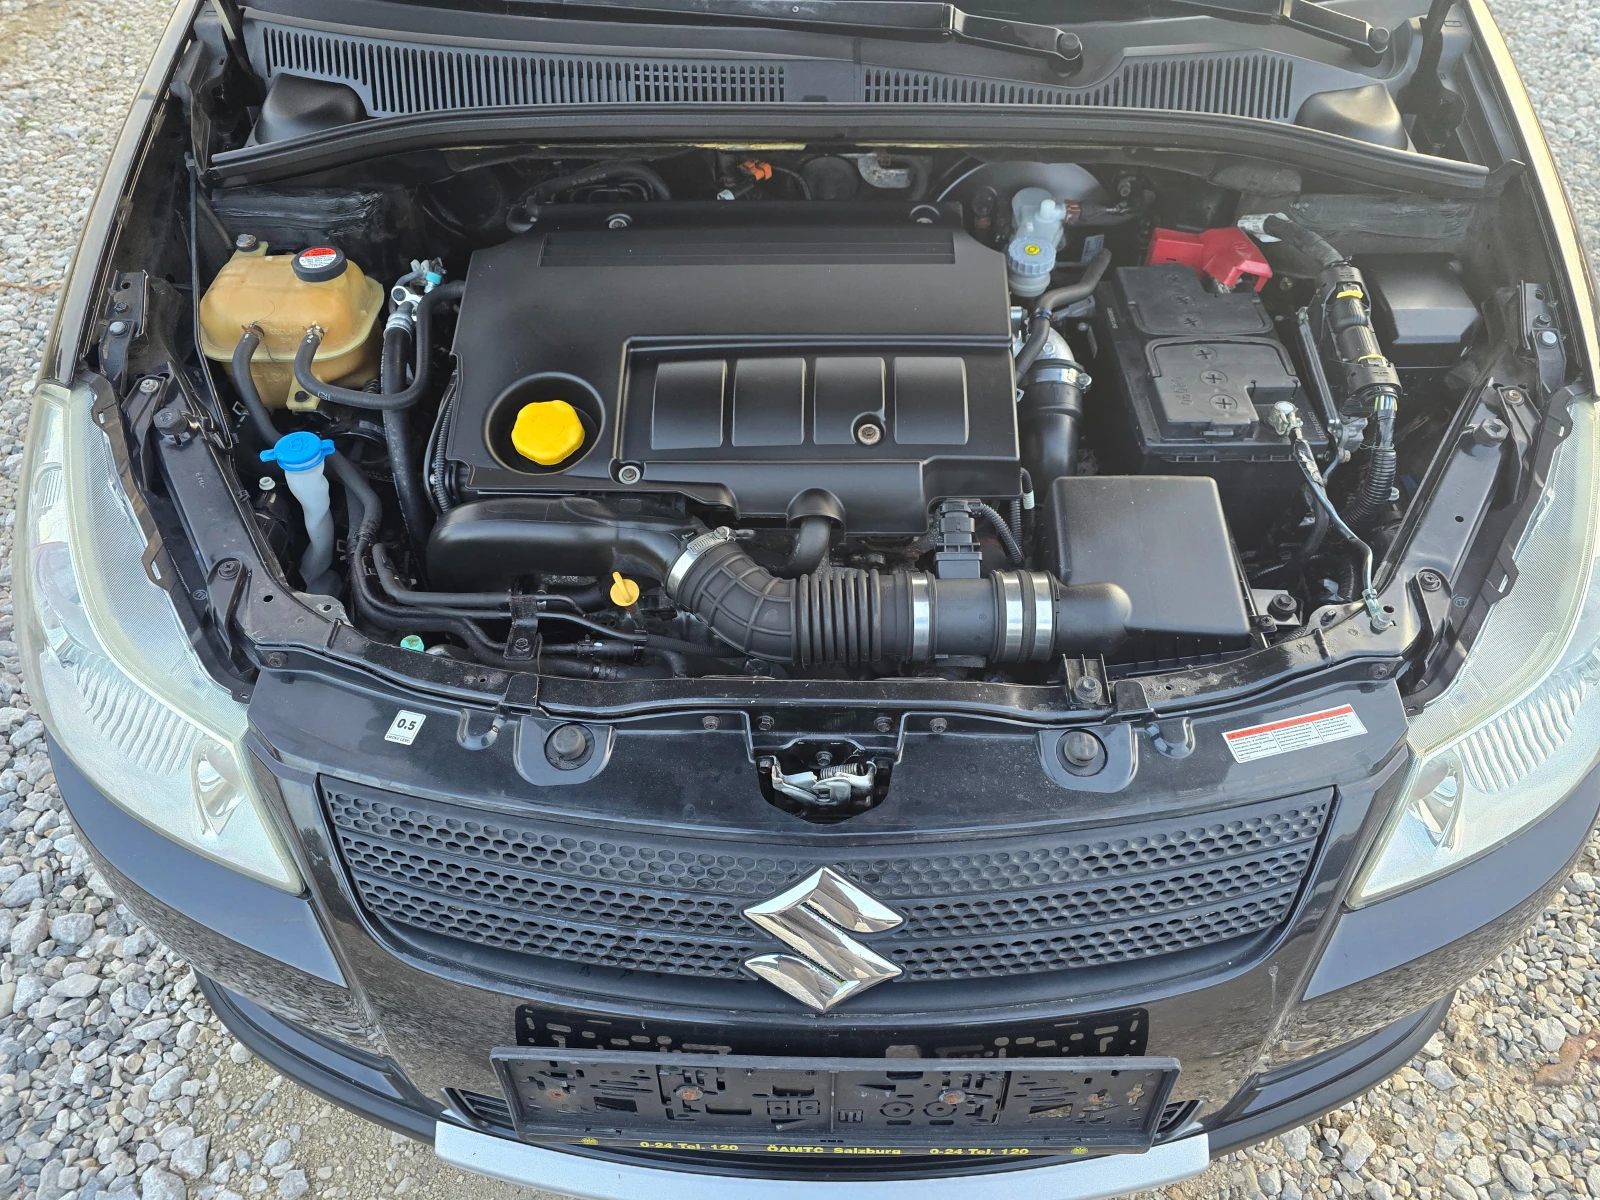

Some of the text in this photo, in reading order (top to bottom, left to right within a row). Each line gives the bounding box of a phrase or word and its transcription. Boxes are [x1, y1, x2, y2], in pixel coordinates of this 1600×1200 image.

[397, 718, 417, 731] 0.5
[639, 1141, 673, 1149] 0-24
[677, 1142, 705, 1150] Tel.
[766, 1144, 824, 1153] ÖAMTC
[833, 1147, 901, 1155] Salzburg
